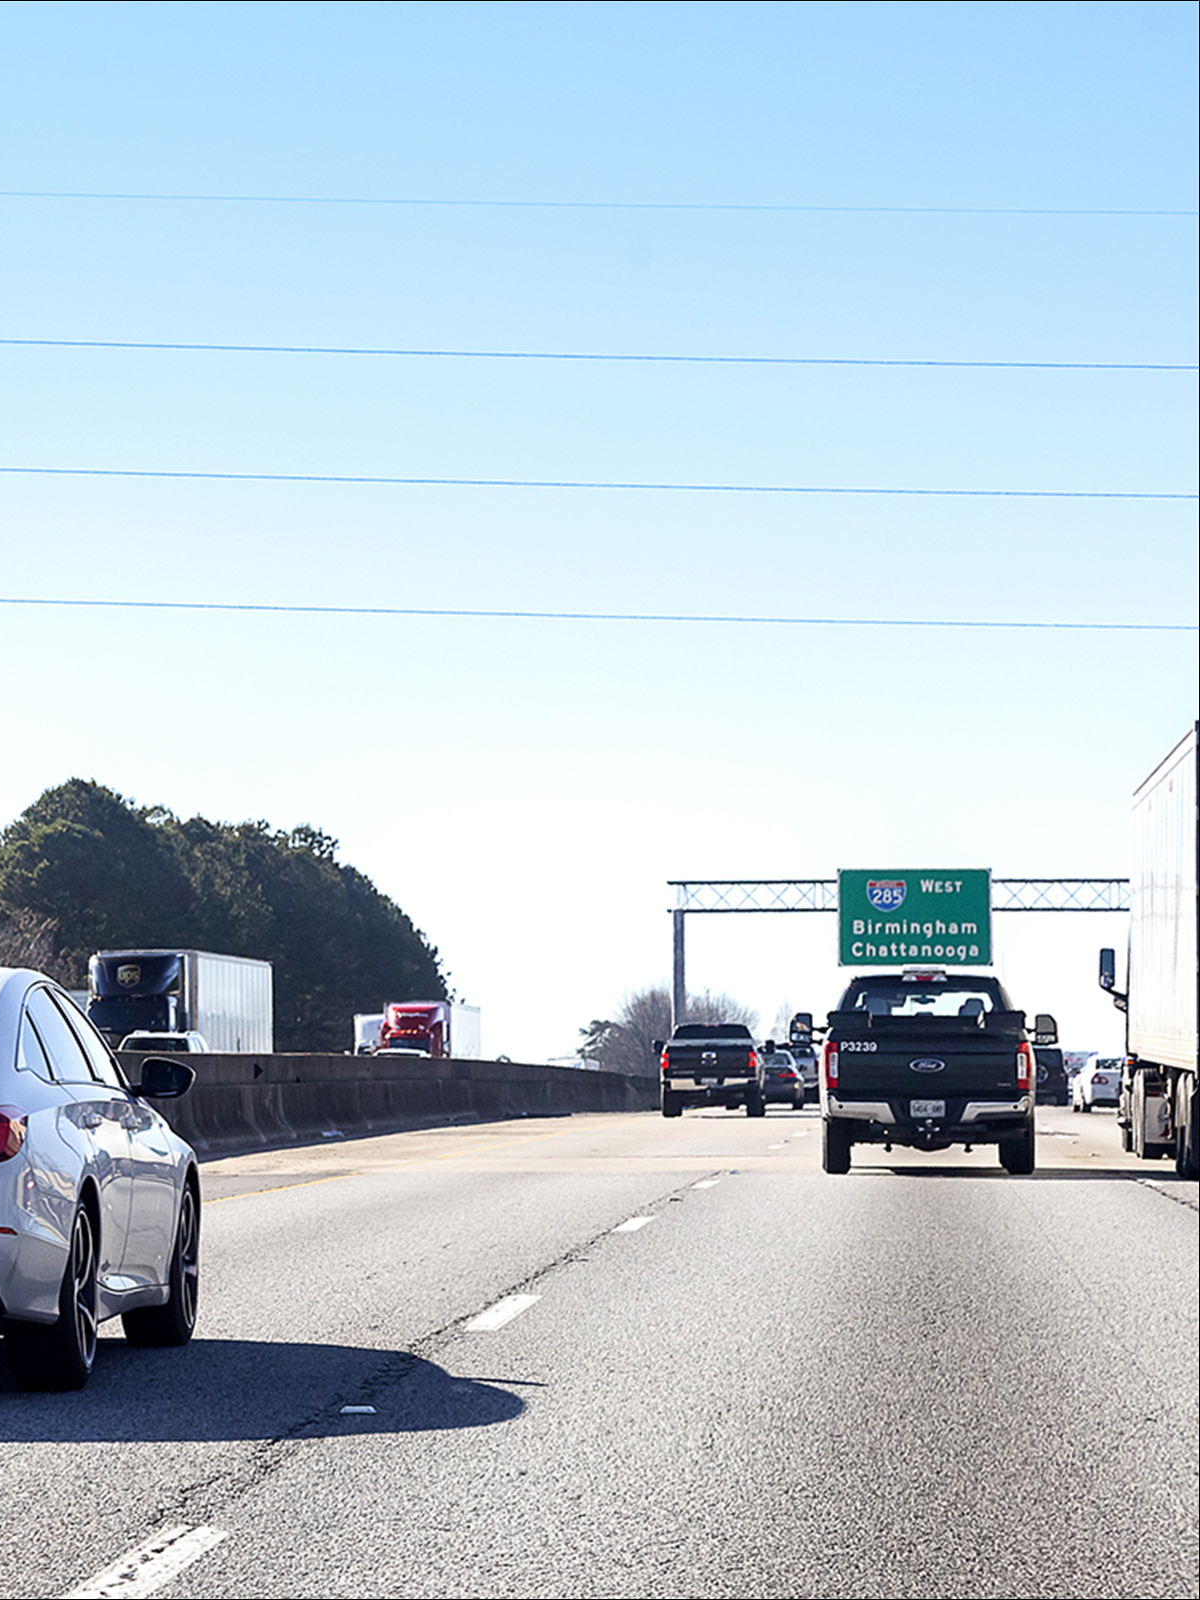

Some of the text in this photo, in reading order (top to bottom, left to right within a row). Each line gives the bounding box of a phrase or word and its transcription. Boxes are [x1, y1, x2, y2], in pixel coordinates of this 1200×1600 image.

[920, 879, 962, 893] WEST
[872, 889, 902, 904] 285
[853, 920, 977, 938] Birmingham
[852, 942, 979, 961] Chattanooga
[840, 1041, 878, 1052] P3239
